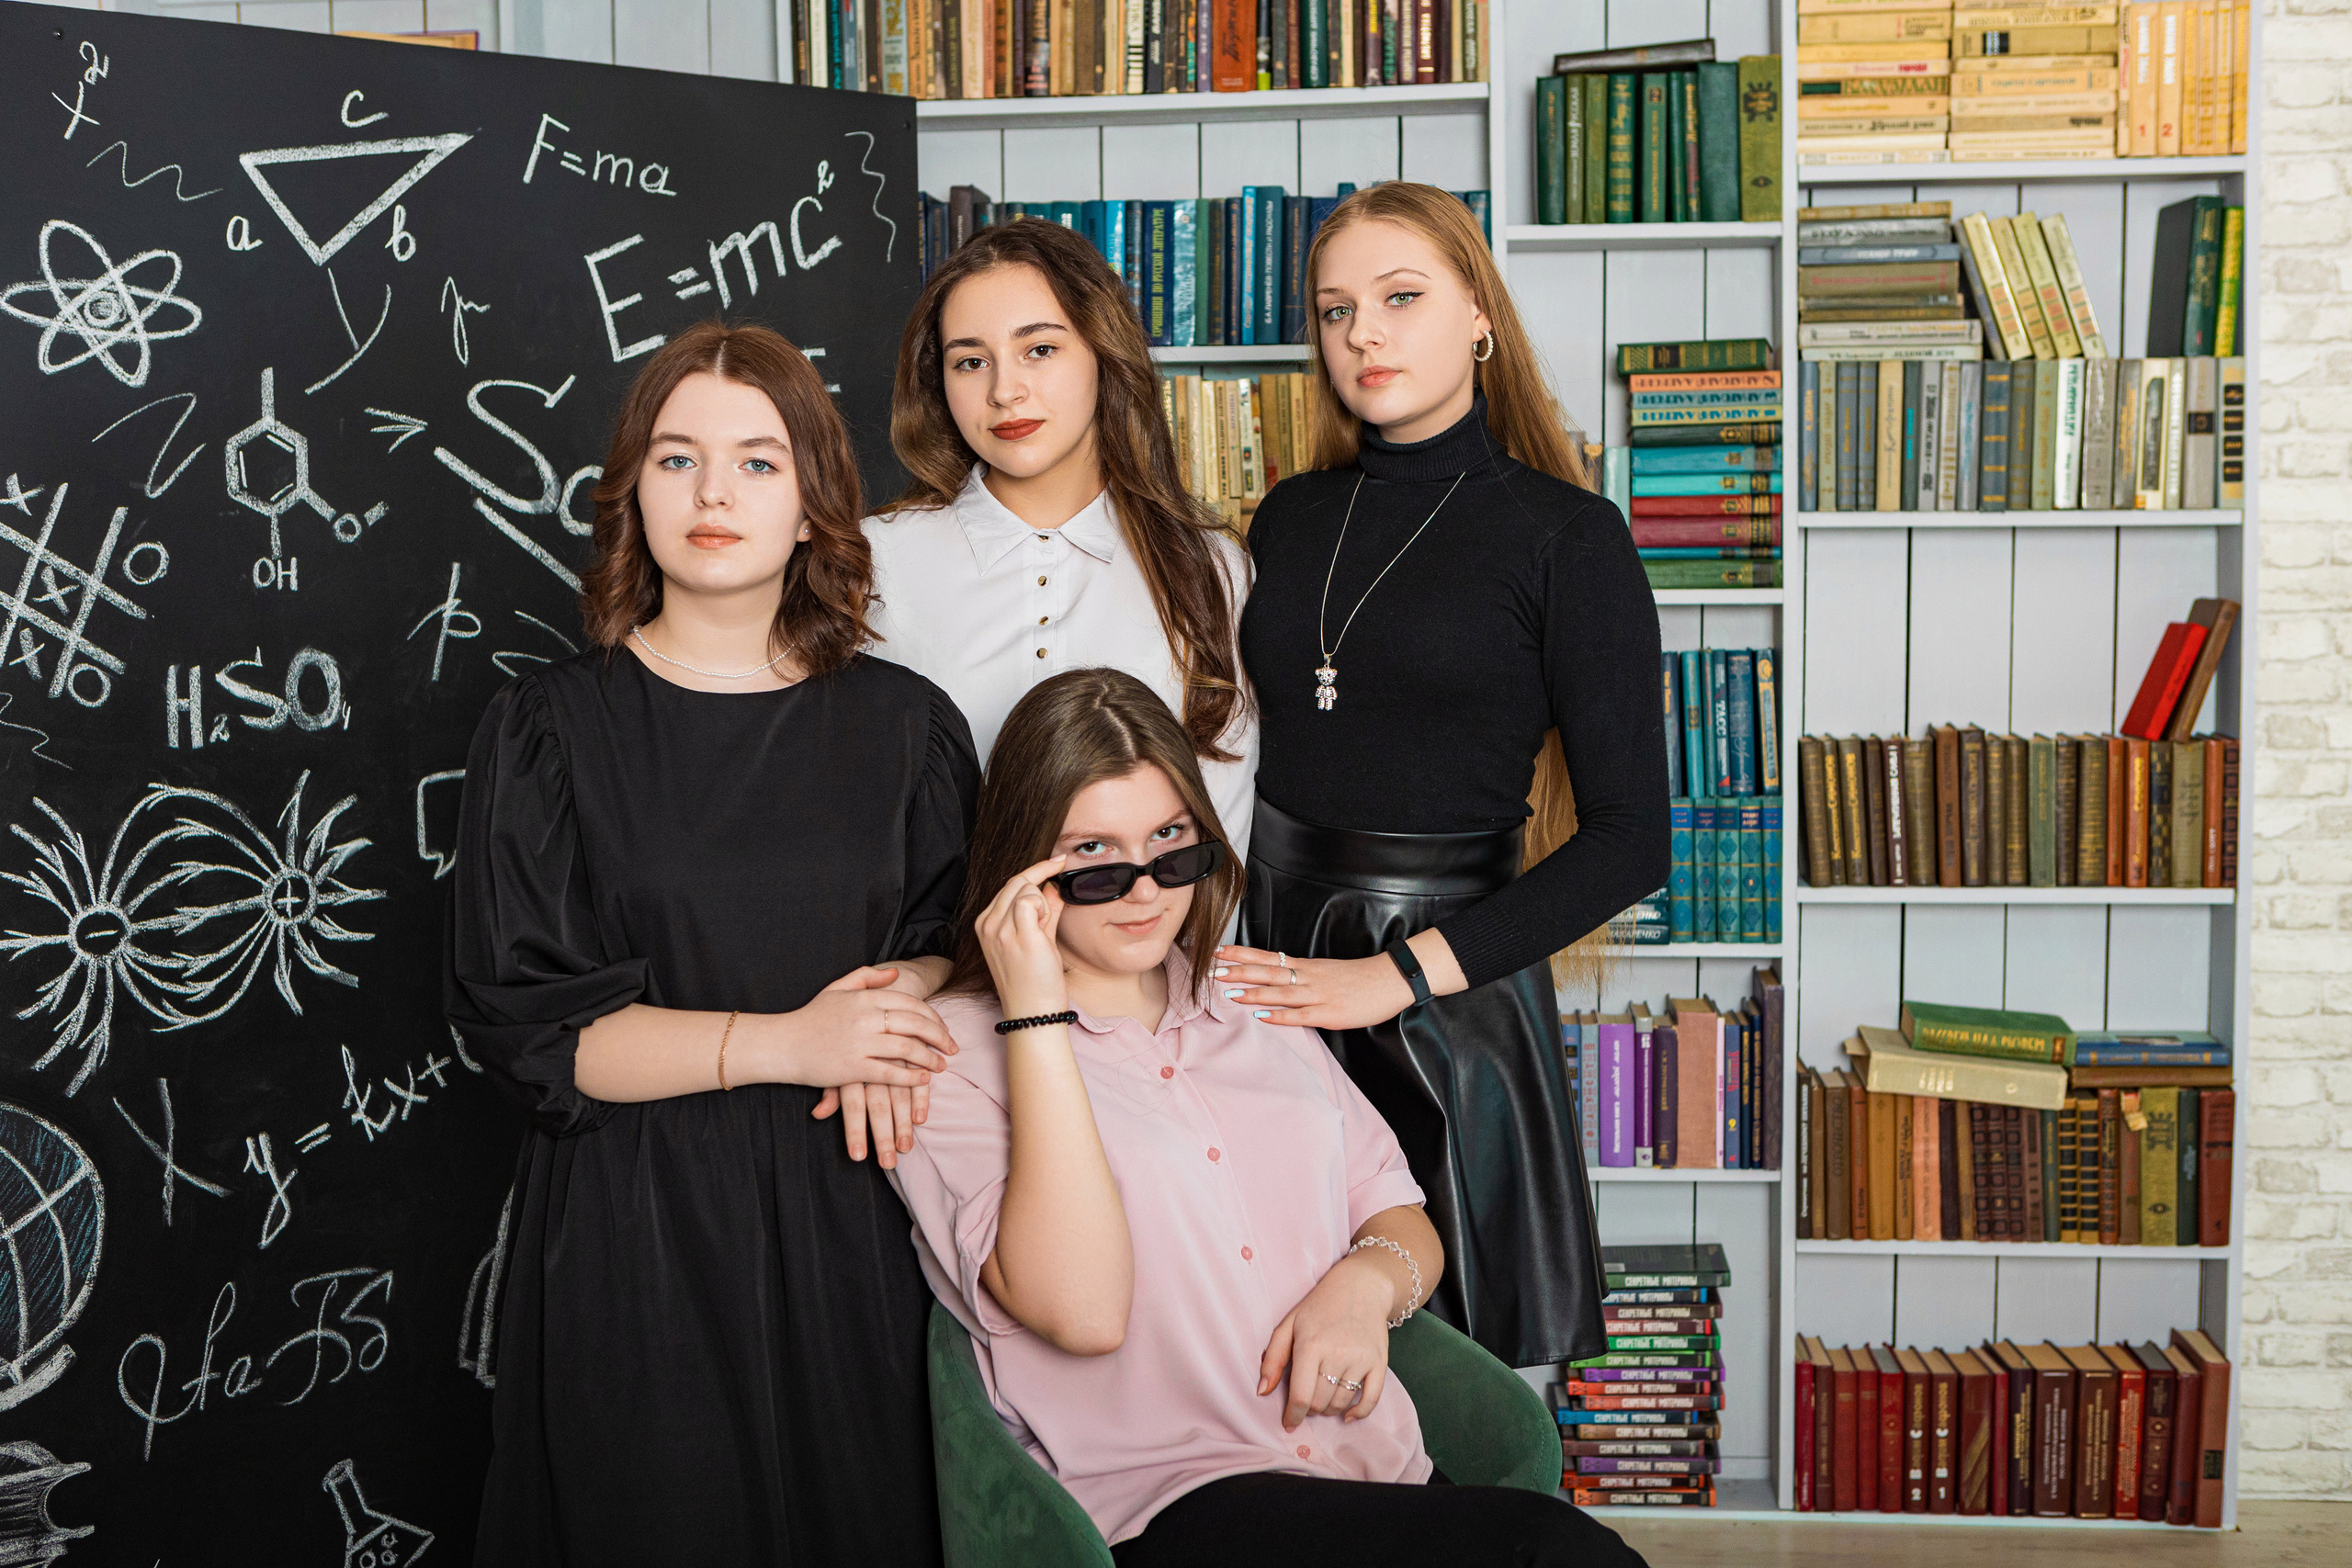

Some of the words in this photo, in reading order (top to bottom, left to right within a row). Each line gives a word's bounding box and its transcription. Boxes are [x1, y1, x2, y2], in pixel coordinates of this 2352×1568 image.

[1152, 208, 1164, 251] ЛИТЕРАТУРЕ
[1152, 252, 1164, 282] РУССКОЙ
[1152, 296, 1164, 337] СОЧИНЕНИЯ
[253, 557, 298, 591] OH
[1715, 700, 1726, 736] ТАСС
[1910, 1488, 1921, 1501] 2
[1938, 1487, 1946, 1500] 1
